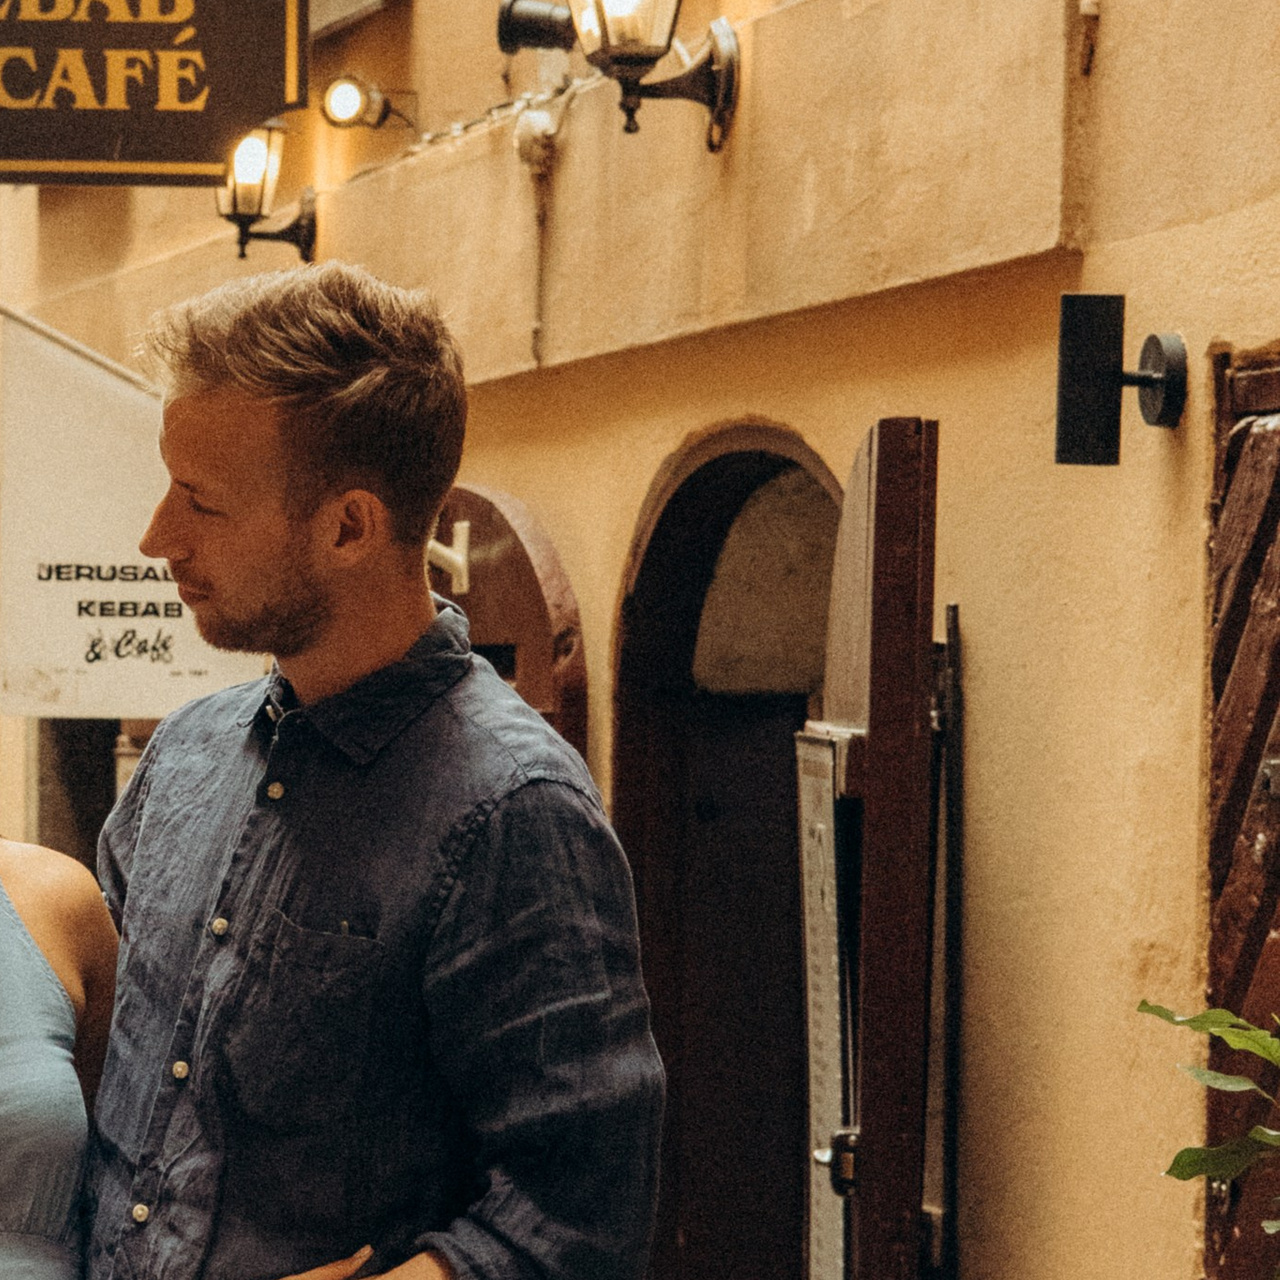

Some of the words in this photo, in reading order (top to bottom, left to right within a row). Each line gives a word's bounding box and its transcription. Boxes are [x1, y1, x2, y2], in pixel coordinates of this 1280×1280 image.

[37, 563, 176, 583] JERUSAL
[77, 600, 184, 619] KEBAB
[84, 634, 104, 664] &
